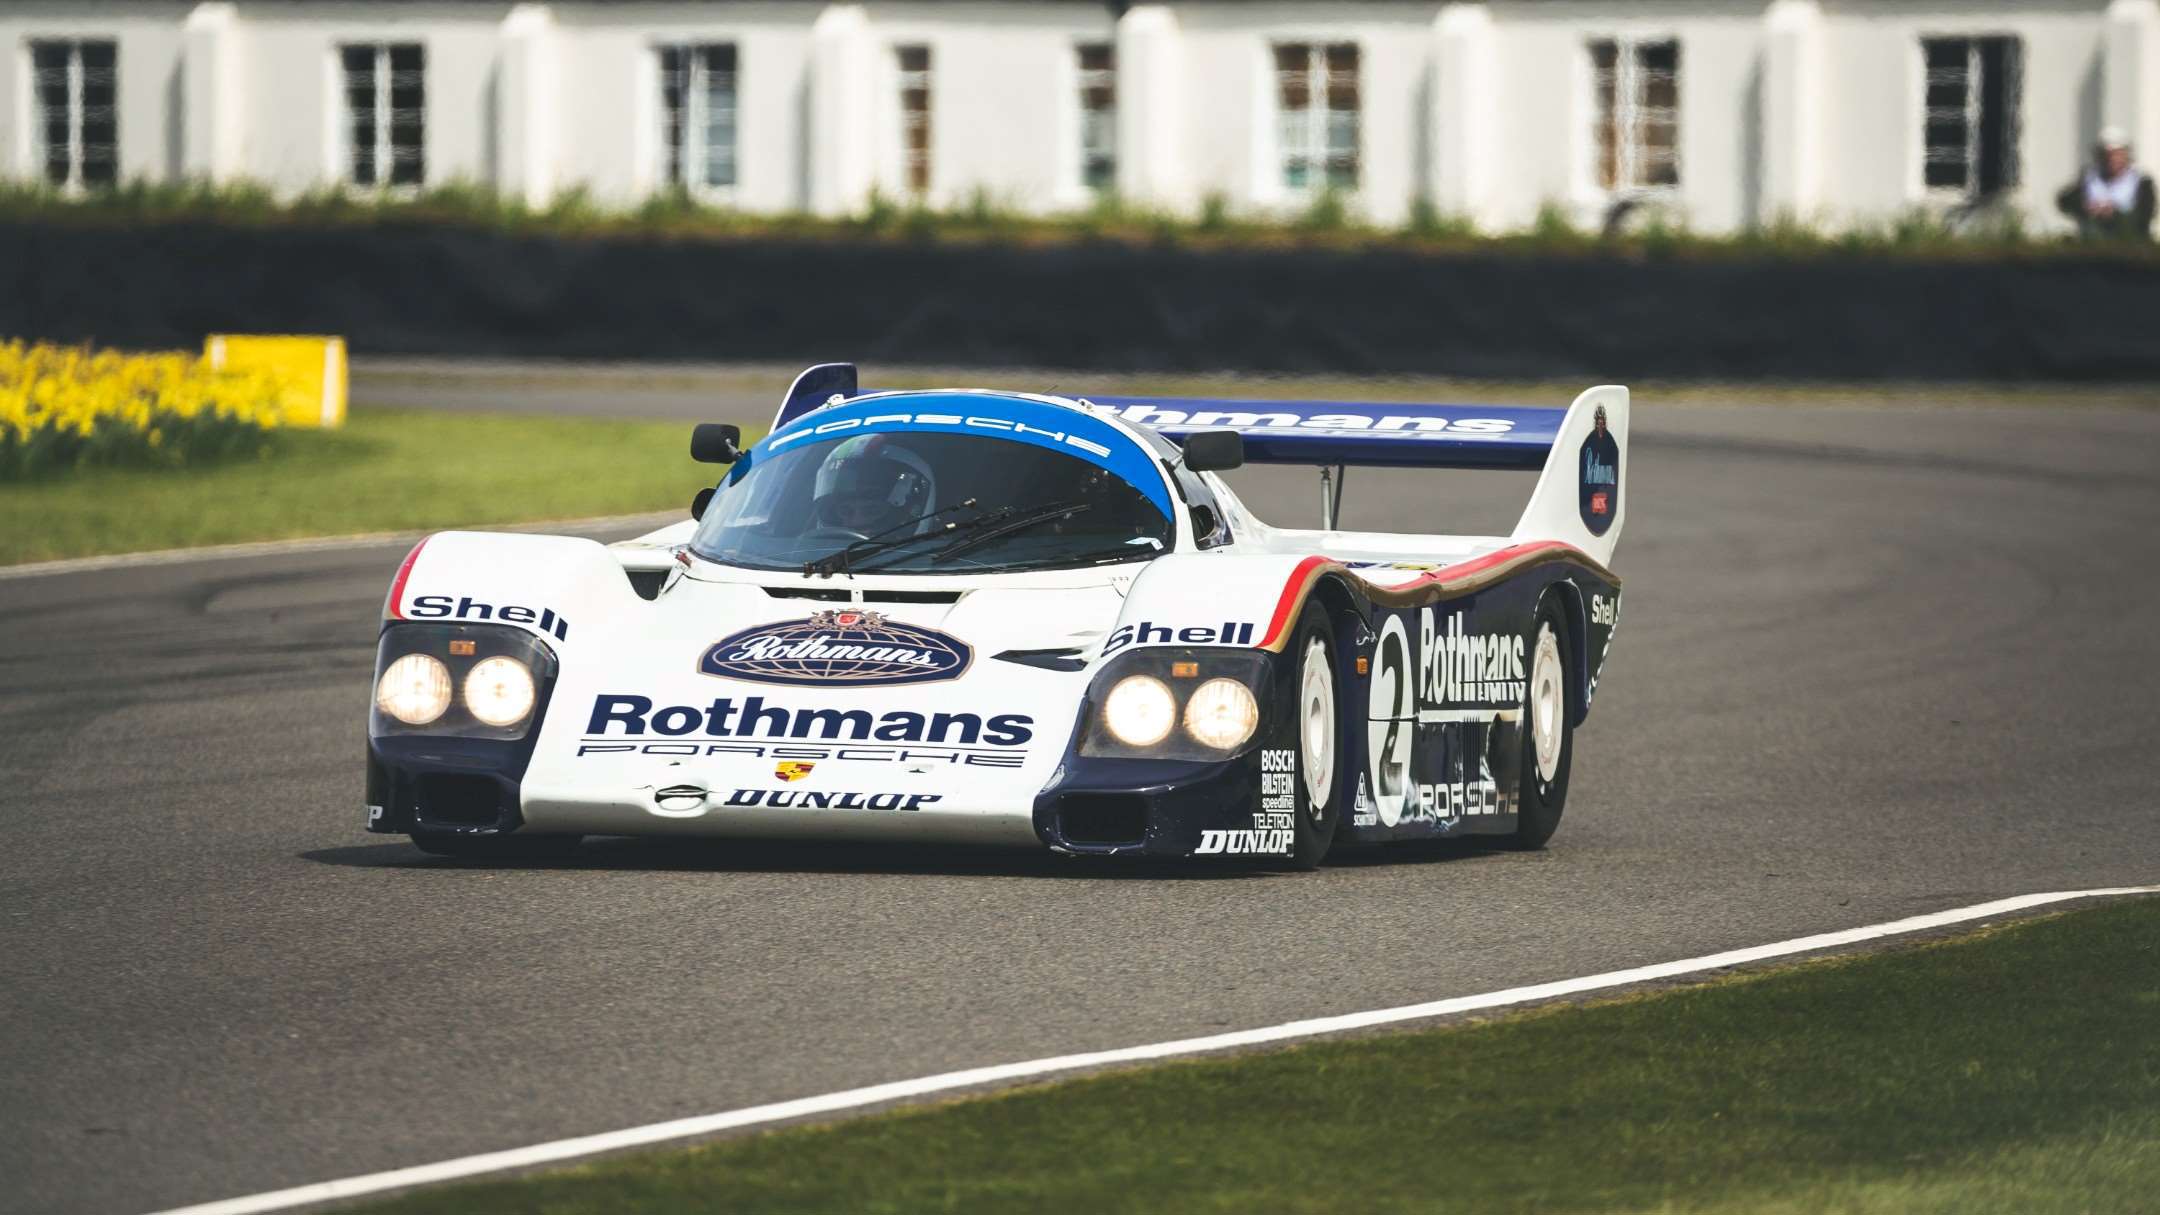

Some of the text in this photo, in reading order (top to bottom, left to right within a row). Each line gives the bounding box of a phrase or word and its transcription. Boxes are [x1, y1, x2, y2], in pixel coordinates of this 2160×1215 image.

[768, 414, 1111, 459] PORSCHE
[410, 596, 569, 642] Shell
[1592, 594, 1615, 625] Shell
[728, 635, 940, 667] Rothmans
[1100, 622, 1255, 657] Shell
[1419, 607, 1527, 704] Rothmans
[586, 694, 1035, 746] Rothmans
[1379, 631, 1404, 796] 2
[577, 744, 1029, 768] PORSCHE
[1261, 750, 1295, 772] BOSCH
[724, 789, 943, 811] DUNLOP
[1262, 773, 1295, 795] BILSTEIN
[1194, 830, 1295, 853] DUNLOP
